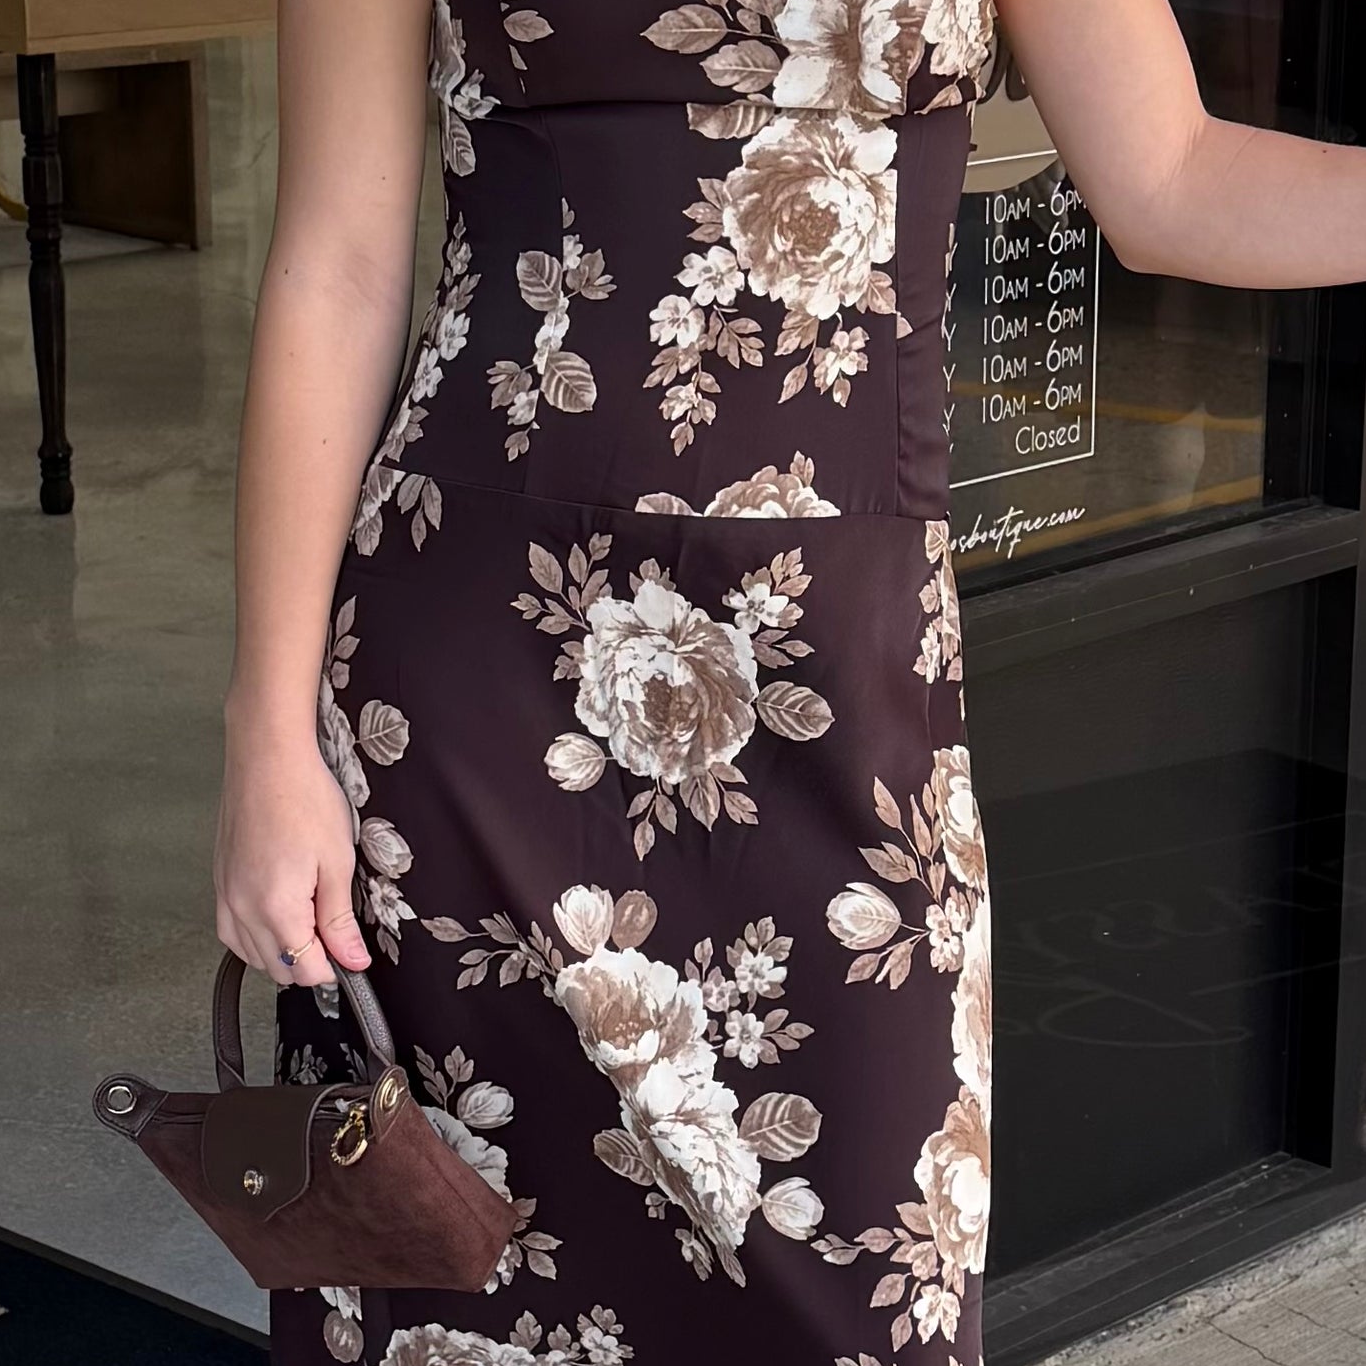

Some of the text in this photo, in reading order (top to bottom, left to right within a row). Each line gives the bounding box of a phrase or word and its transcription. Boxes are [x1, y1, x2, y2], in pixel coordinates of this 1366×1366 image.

[985, 194, 1030, 224] 10AM
[985, 234, 1029, 264] 10AM
[1048, 221, 1085, 255] 6PM
[984, 275, 1029, 304] 10AM
[1047, 261, 1085, 294] 6PM
[983, 315, 1028, 345] 10AM
[1046, 300, 1084, 333] 6PM
[983, 354, 1027, 384] 10AM
[1046, 339, 1083, 372] 6PM
[982, 393, 1026, 423] 10AM
[1044, 377, 1082, 411] 6PM
[1014, 414, 1081, 455] Closed
